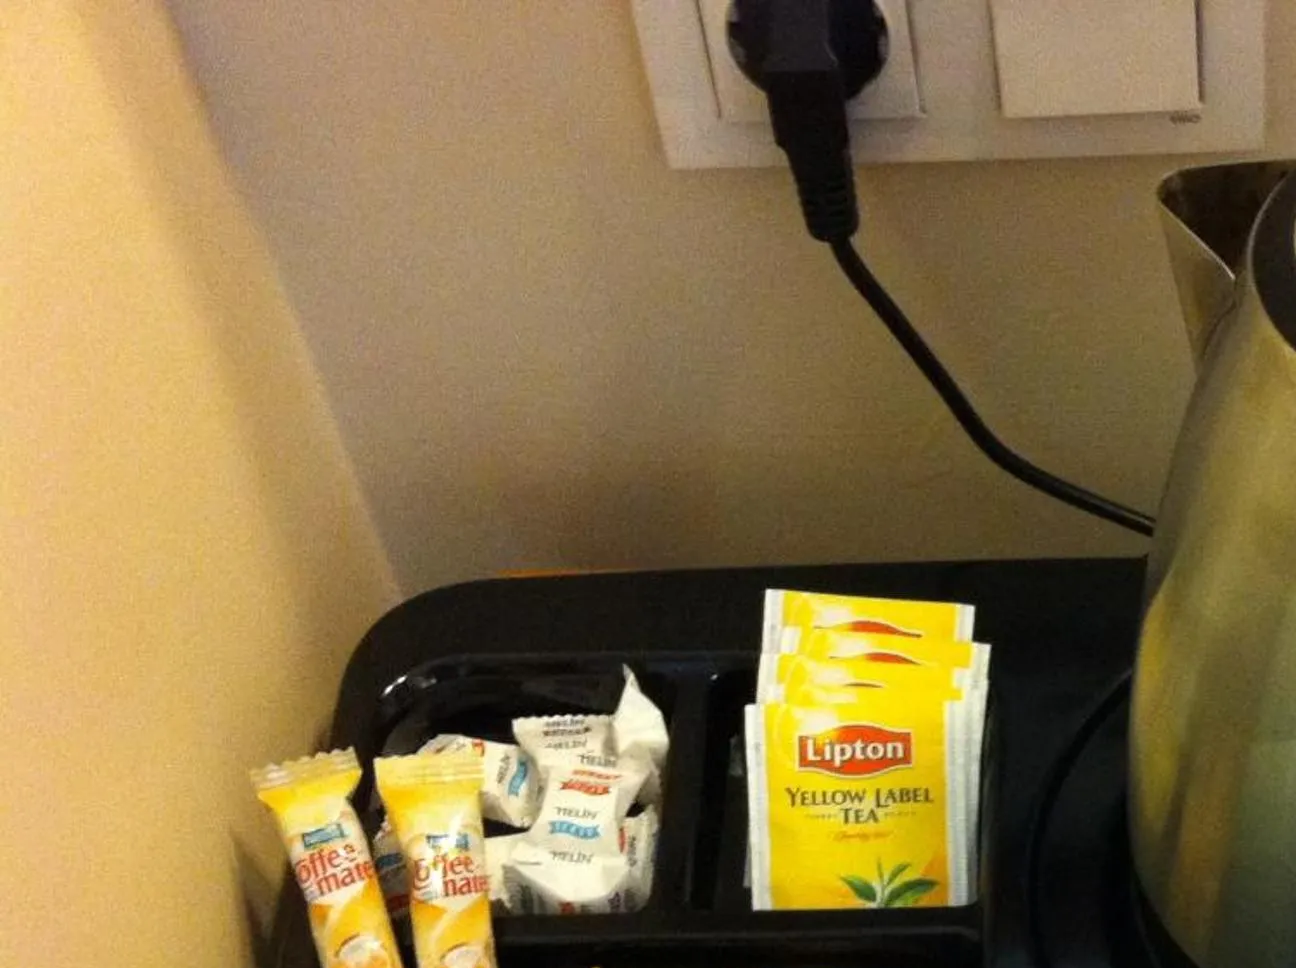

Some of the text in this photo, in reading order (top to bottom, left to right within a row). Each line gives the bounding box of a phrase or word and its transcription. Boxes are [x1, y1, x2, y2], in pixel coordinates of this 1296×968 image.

[806, 738, 905, 768] Lipton
[785, 787, 934, 808] YELLOW LABEL
[840, 807, 880, 825] TEA
